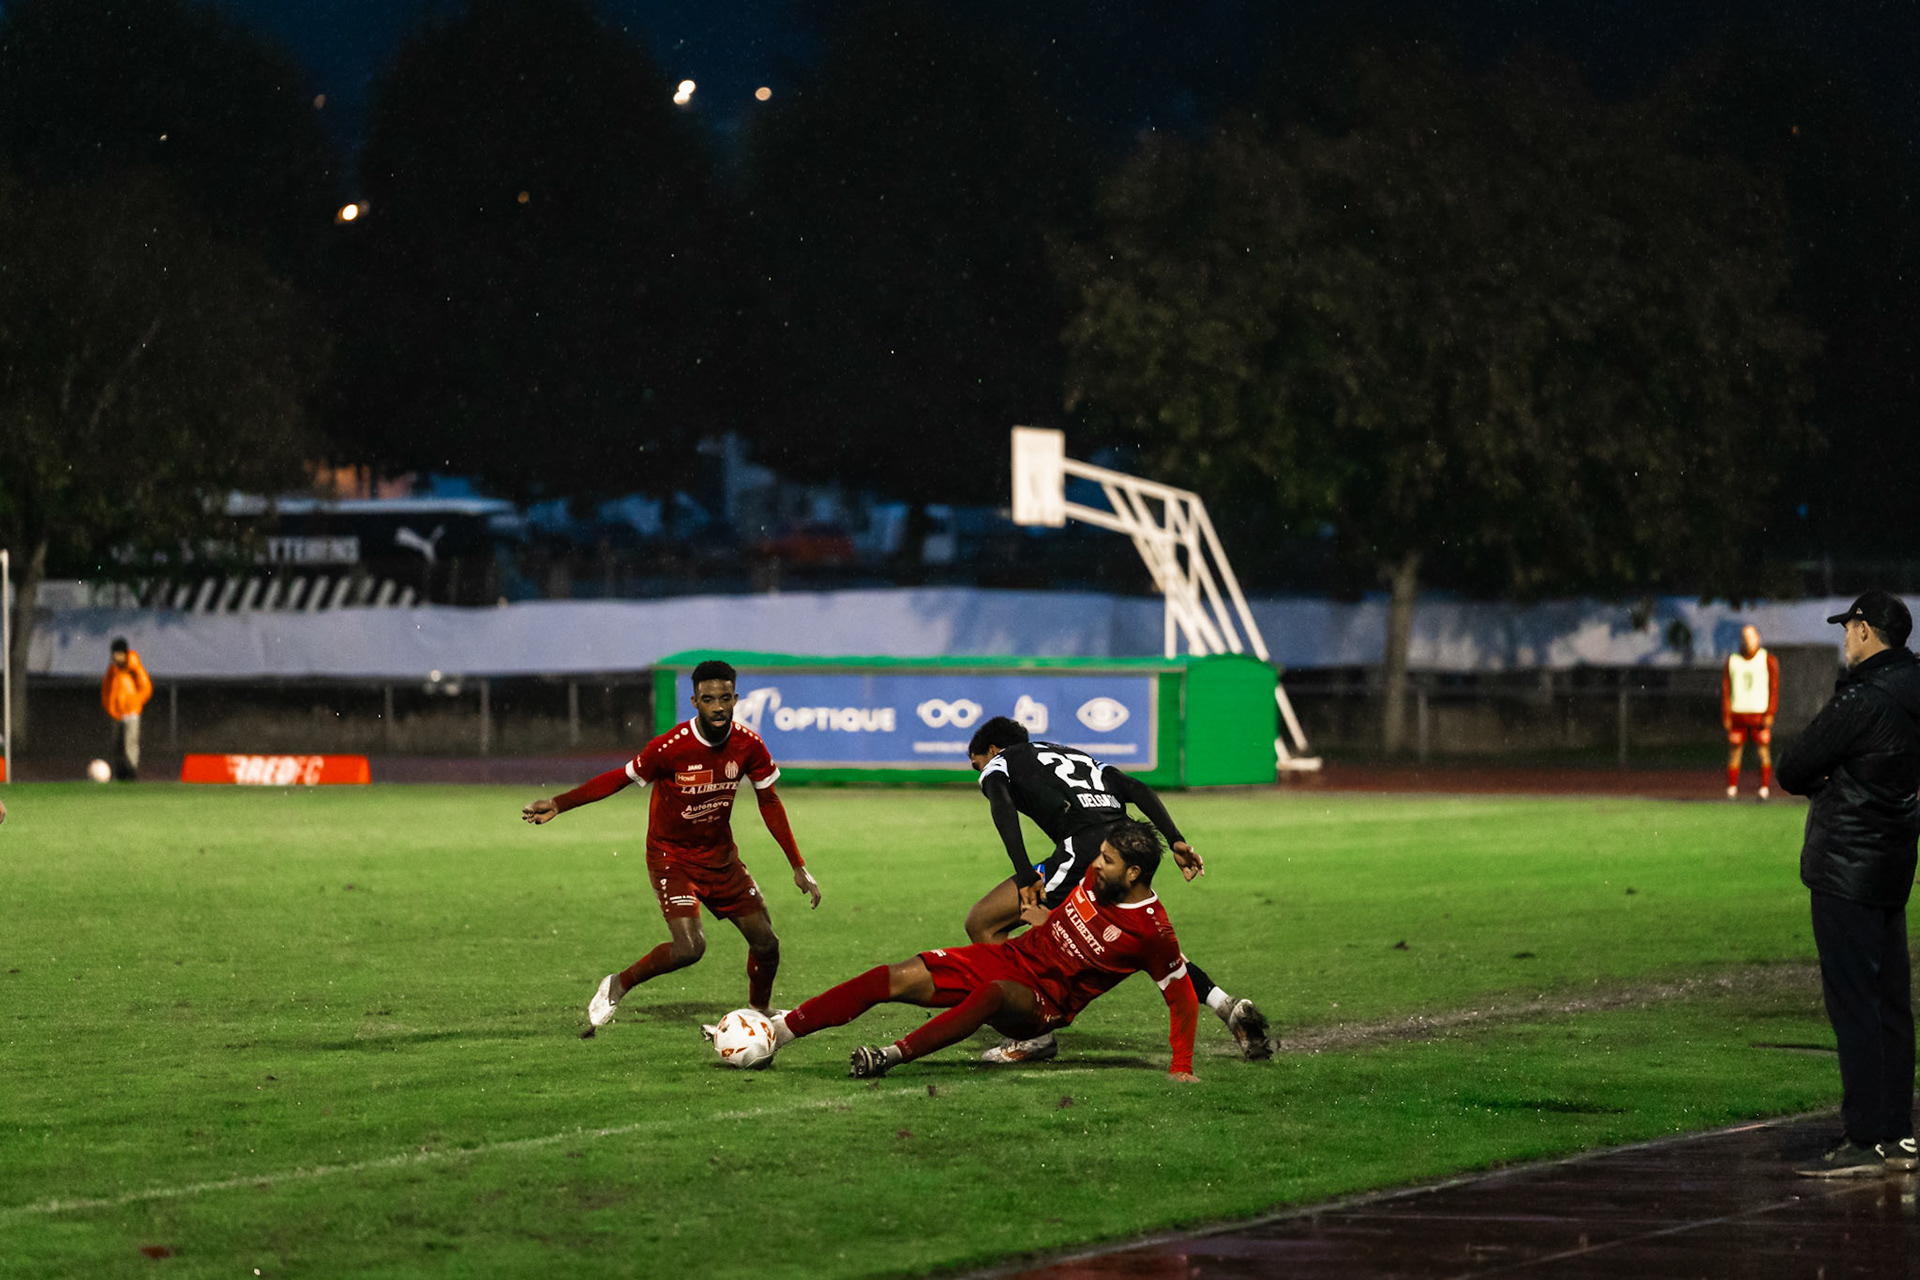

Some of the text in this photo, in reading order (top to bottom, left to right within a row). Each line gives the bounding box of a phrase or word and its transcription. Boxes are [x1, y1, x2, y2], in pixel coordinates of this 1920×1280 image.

[774, 706, 896, 732] OPTIQUE
[1036, 752, 1105, 791] 27
[681, 786, 696, 795] LA
[685, 801, 729, 812] Autonova
[1071, 912, 1105, 955] LIBERTÉ
